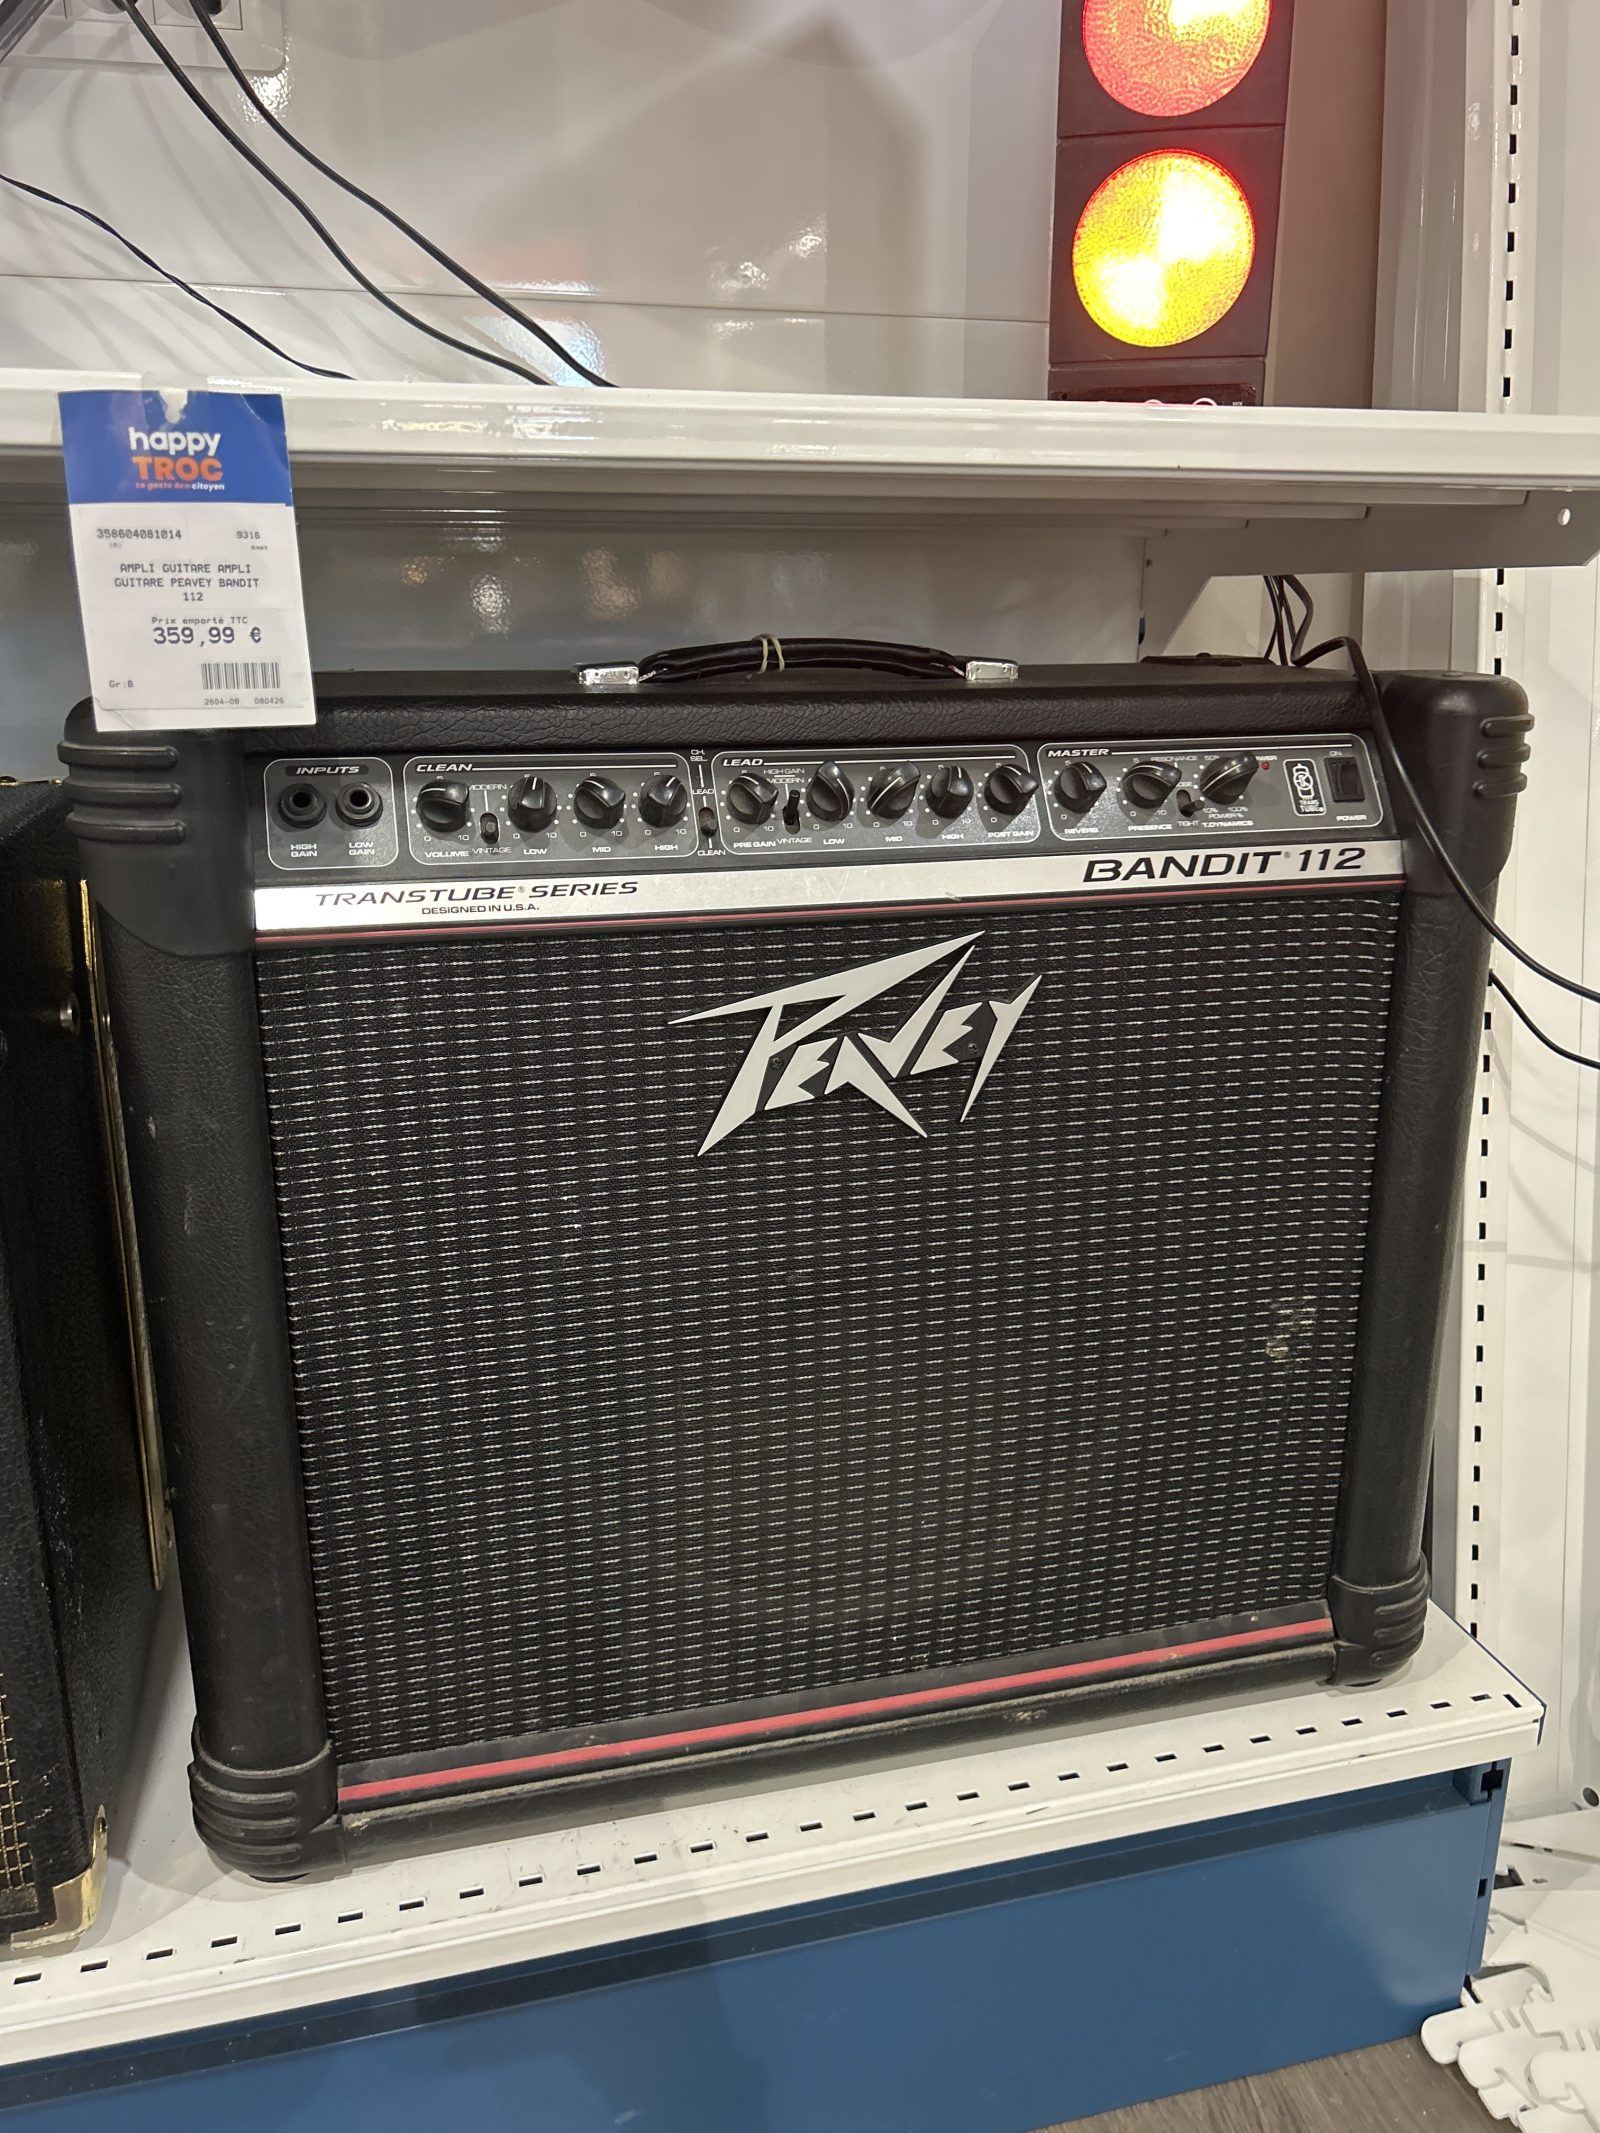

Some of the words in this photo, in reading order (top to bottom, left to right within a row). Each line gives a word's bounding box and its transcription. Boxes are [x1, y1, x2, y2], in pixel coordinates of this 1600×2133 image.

[128, 426, 222, 456] happy
[132, 455, 224, 482] TROC
[96, 528, 182, 539] 358604081014
[236, 530, 261, 540] 9316
[120, 563, 155, 573] AMPLI
[162, 563, 211, 573] GUITARE
[217, 563, 251, 574] AMPLI
[114, 578, 164, 588] GUITARE
[170, 578, 212, 588] PEAVEY
[219, 578, 259, 588] BANDIT
[183, 592, 204, 601] 112
[151, 616, 176, 625] Prix
[182, 616, 224, 626] emporté
[231, 616, 248, 624] TTC
[153, 626, 235, 647] 359,99
[250, 626, 262, 644] €
[1048, 748, 1110, 758] MASTER
[723, 758, 763, 767] LEAD
[296, 766, 360, 775] INPUTS
[416, 763, 473, 773] CLEAN
[1201, 820, 1254, 828] T.DYNAMICS
[457, 833, 470, 841] 10
[545, 831, 558, 839] 10
[942, 832, 964, 840] HIGH
[987, 830, 1011, 838] POST
[753, 840, 776, 848] GAIN
[776, 837, 813, 845] VINTAGE
[823, 837, 845, 845] LOW
[290, 850, 318, 858] GAIN
[425, 850, 470, 858] VOLUME
[472, 846, 512, 854] VINTAGE
[1298, 847, 1366, 872] 112
[529, 882, 638, 898] SERIES
[421, 904, 487, 915] DESIGNED
[488, 904, 501, 913] IN
[503, 902, 540, 912] U.S.A.
[668, 930, 1042, 1156] PEAVEY
